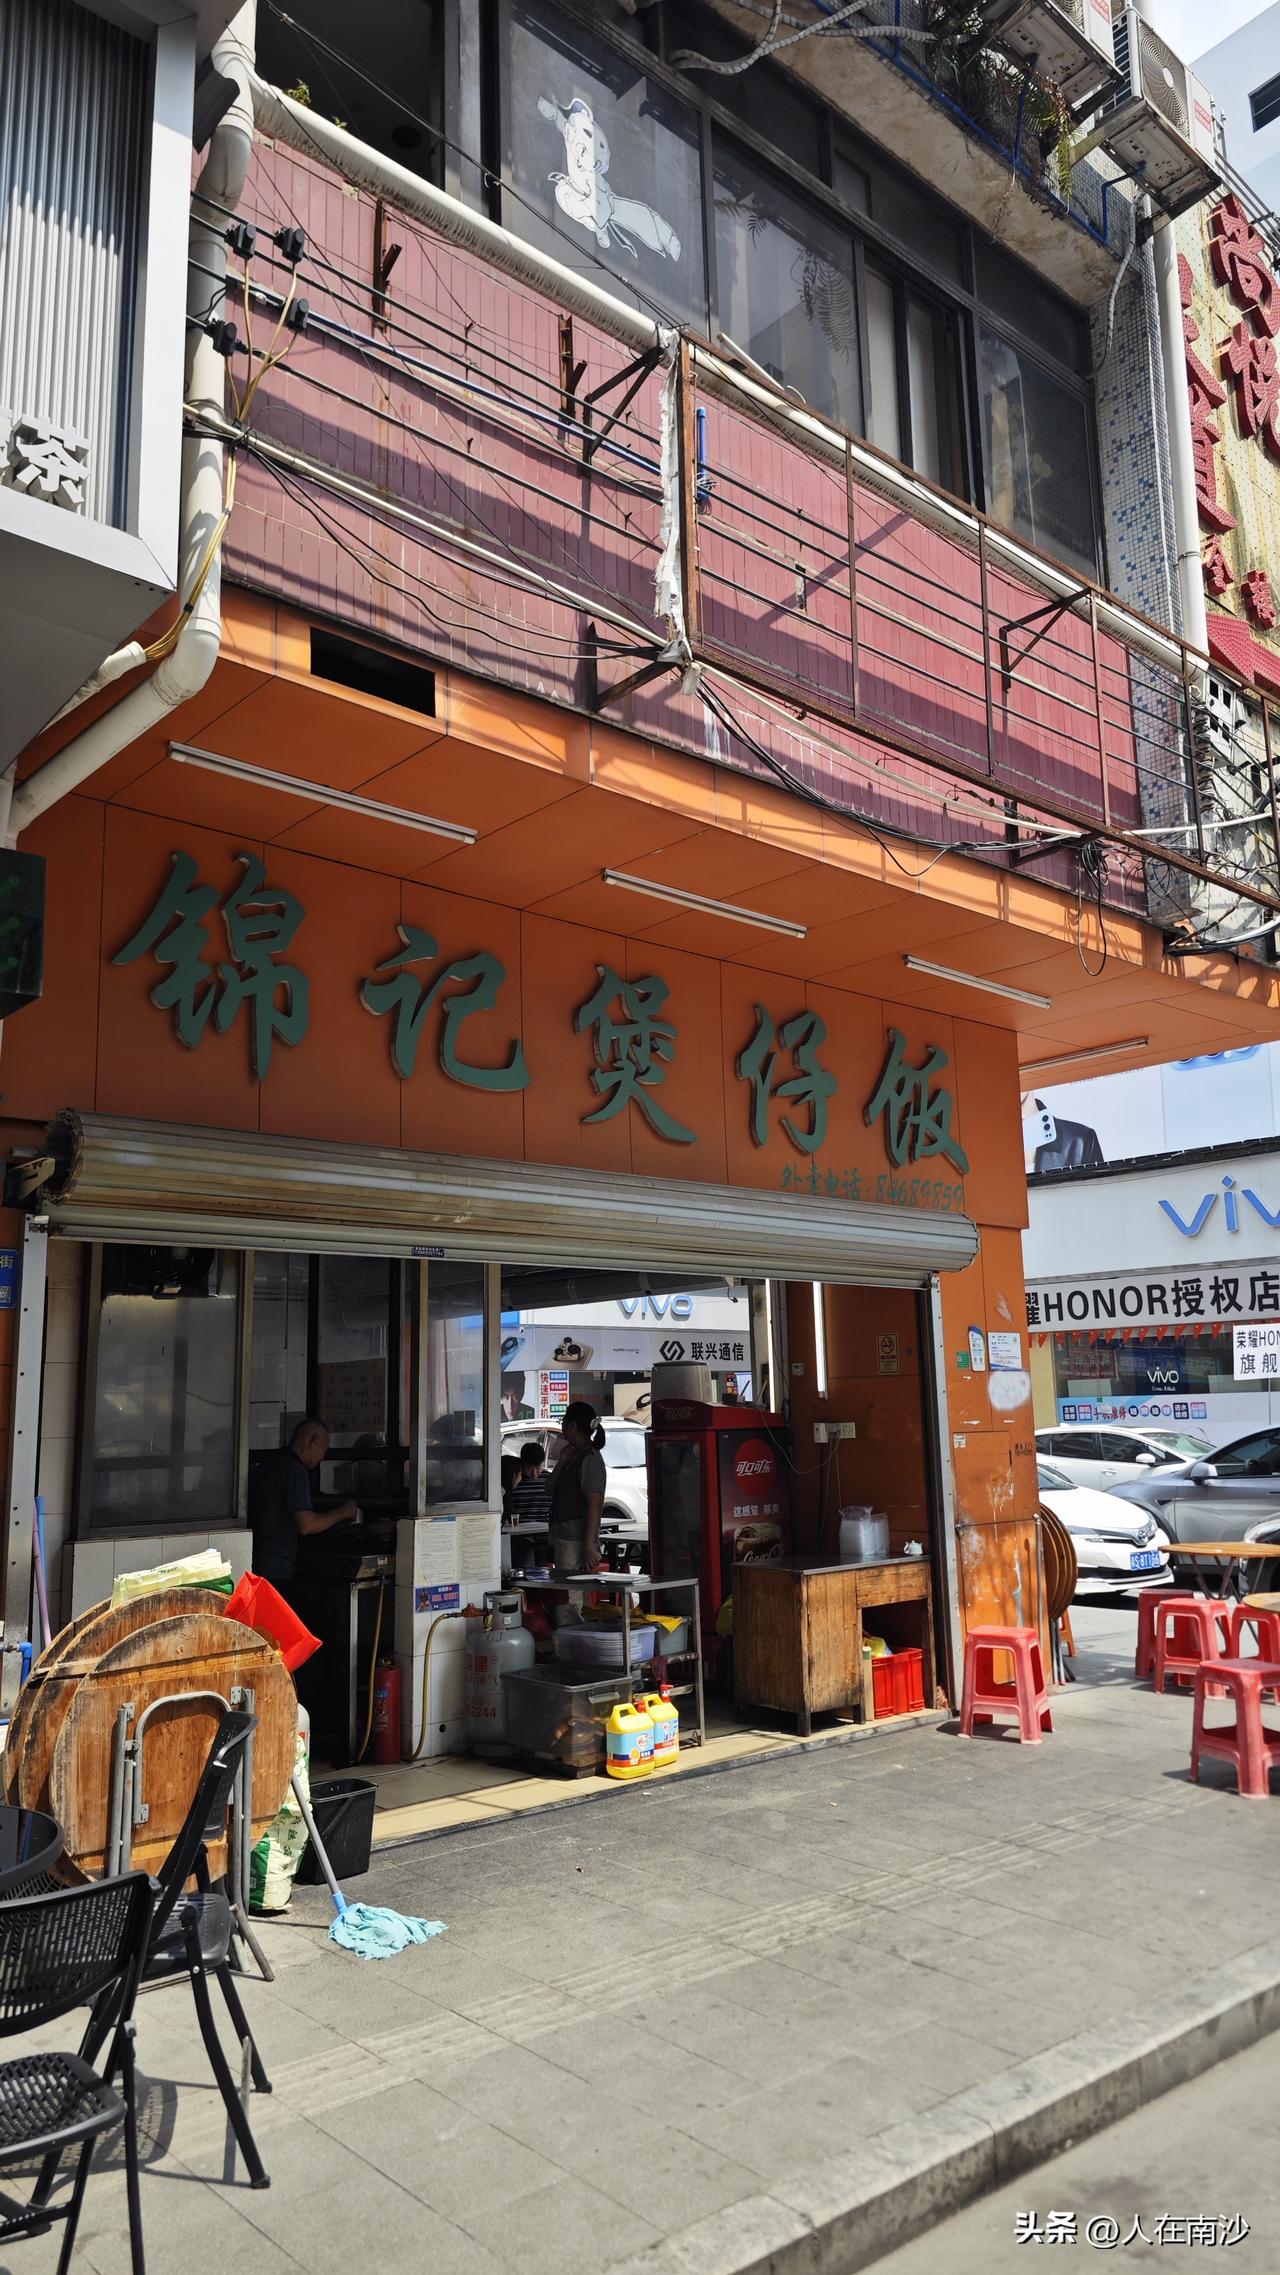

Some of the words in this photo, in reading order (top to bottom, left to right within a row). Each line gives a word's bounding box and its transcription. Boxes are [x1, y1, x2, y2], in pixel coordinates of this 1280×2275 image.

[110, 850, 969, 1174] 锦记煲仔饭
[690, 1342, 745, 1361] 联兴通信
[1146, 1366, 1180, 1384] vivo
[735, 1458, 774, 1477] 可口可乐
